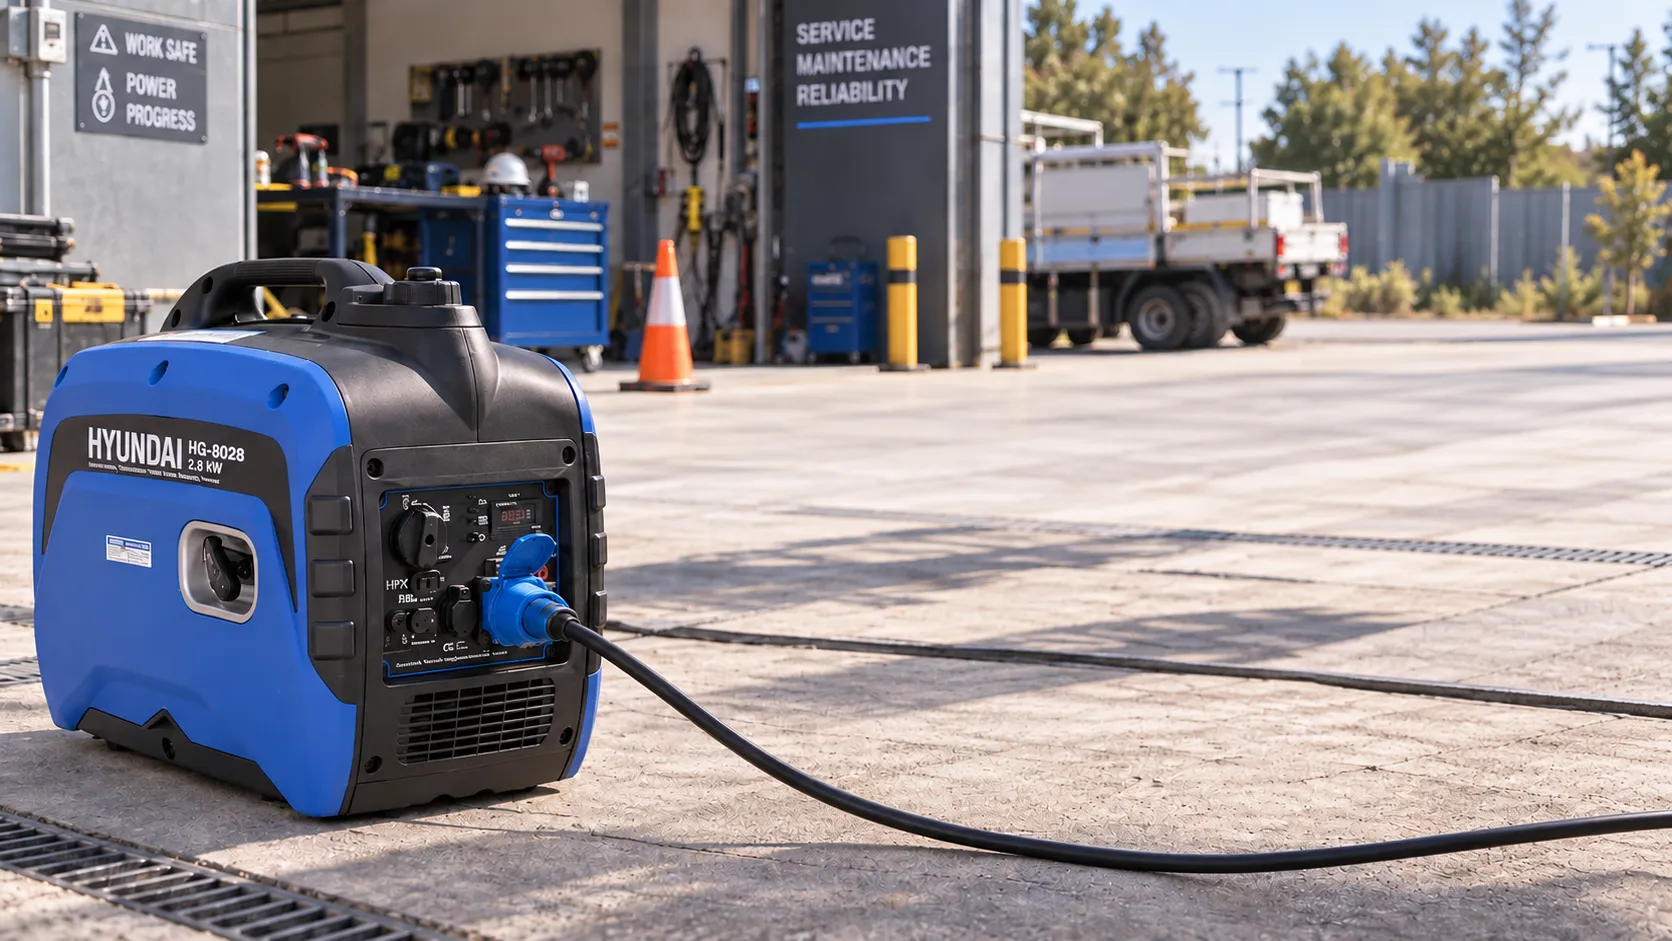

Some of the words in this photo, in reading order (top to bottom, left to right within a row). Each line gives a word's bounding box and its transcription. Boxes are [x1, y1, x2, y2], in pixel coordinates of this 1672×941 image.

[796, 18, 875, 45] SERVICE
[125, 32, 164, 59] WORK
[165, 38, 198, 64] SAFE
[796, 45, 932, 76] MAINTENANCE
[126, 72, 177, 100] POWER
[796, 78, 909, 107] RELIABILITY
[126, 102, 196, 132] PROGRESS
[88, 426, 183, 470] HYUNDAI
[188, 439, 245, 462] HG-8028
[188, 458, 204, 472] 2.8
[206, 461, 223, 475] kW
[386, 578, 409, 591] HPX
